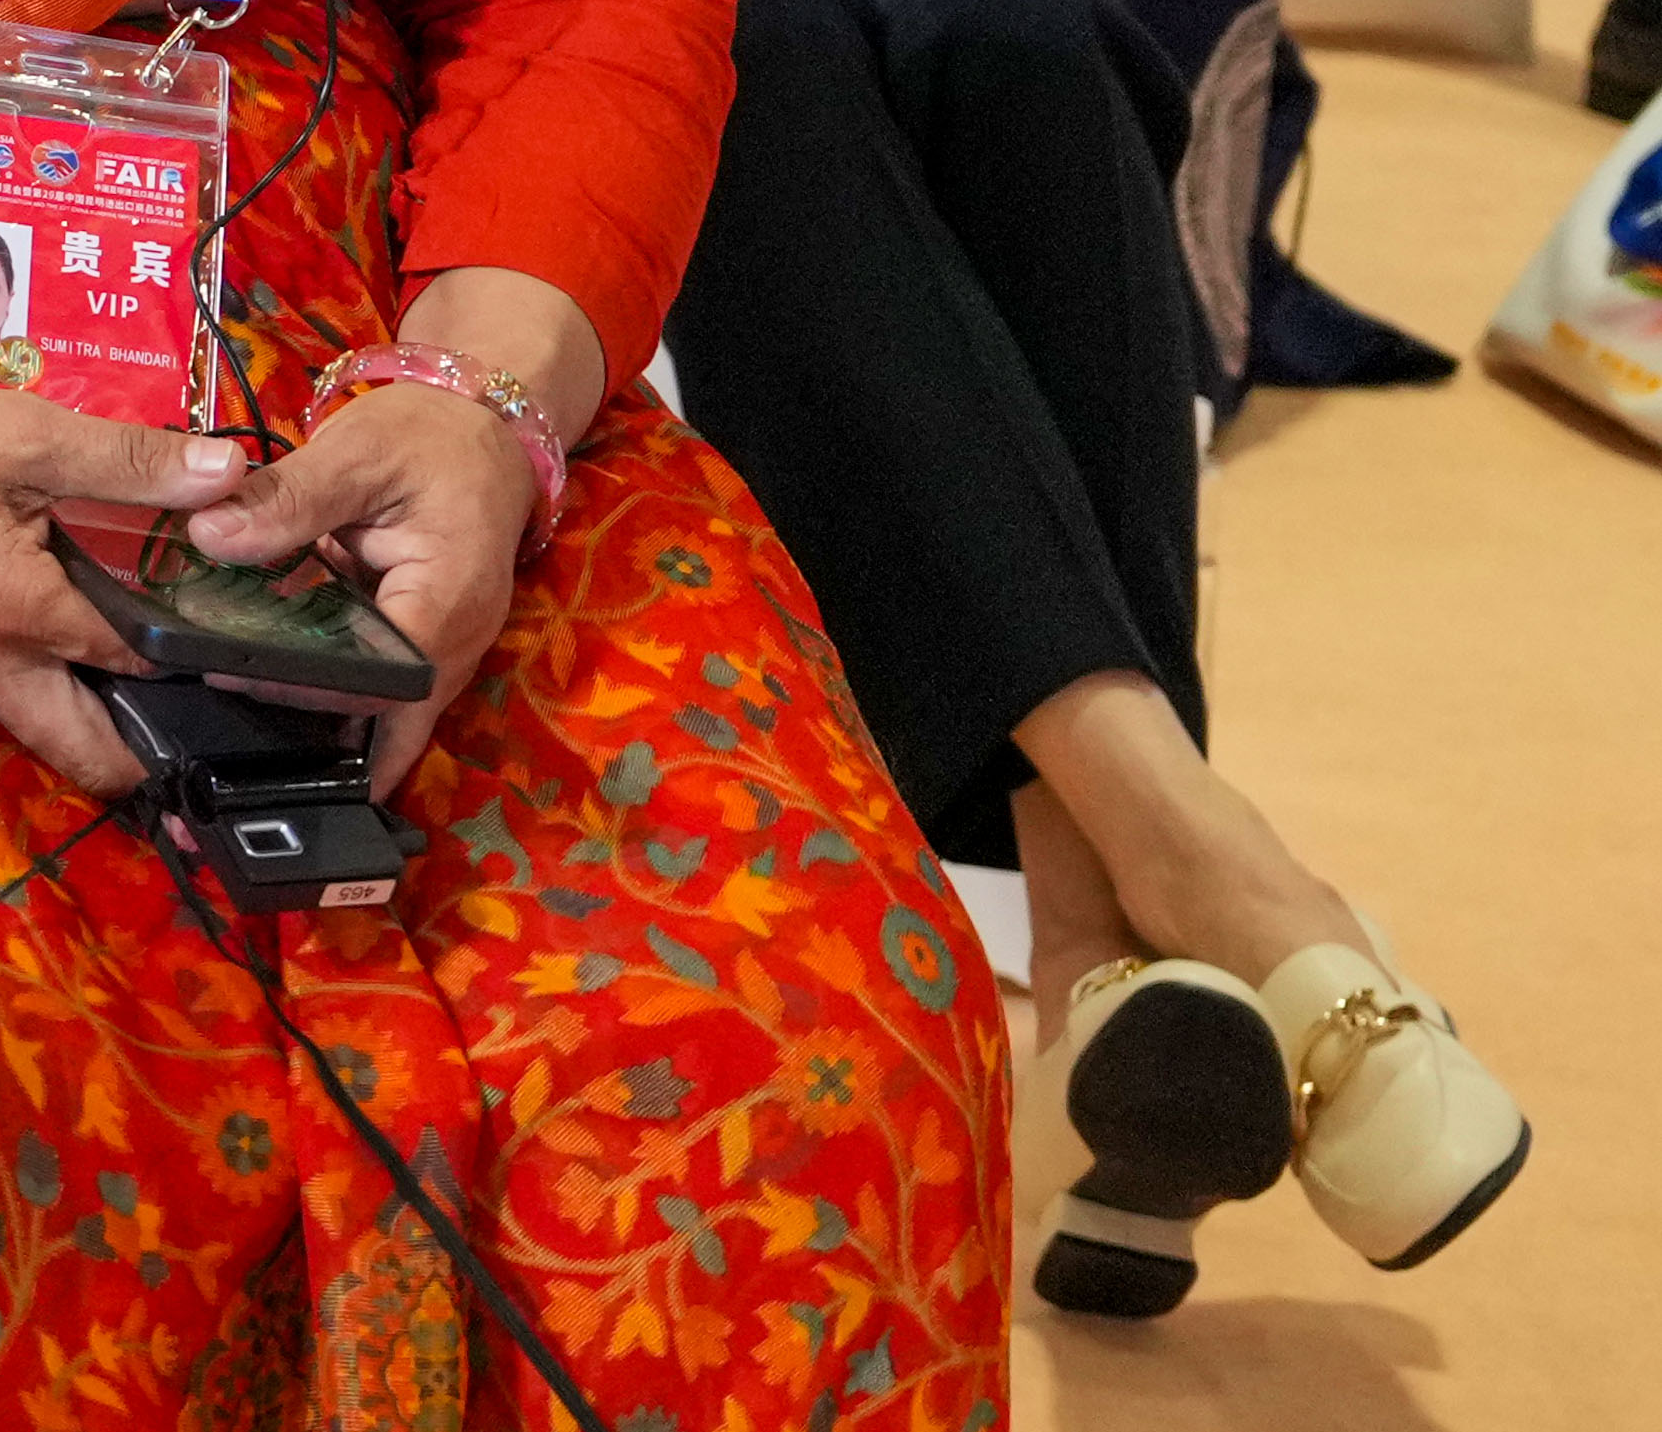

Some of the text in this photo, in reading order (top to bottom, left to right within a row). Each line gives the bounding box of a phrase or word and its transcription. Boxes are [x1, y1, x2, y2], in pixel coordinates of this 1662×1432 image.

[95, 158, 185, 194] FAIR
[61, 231, 172, 288] 贵宾
[87, 290, 140, 318] VIP
[40, 336, 178, 369] SUMITRA BHANDARI
